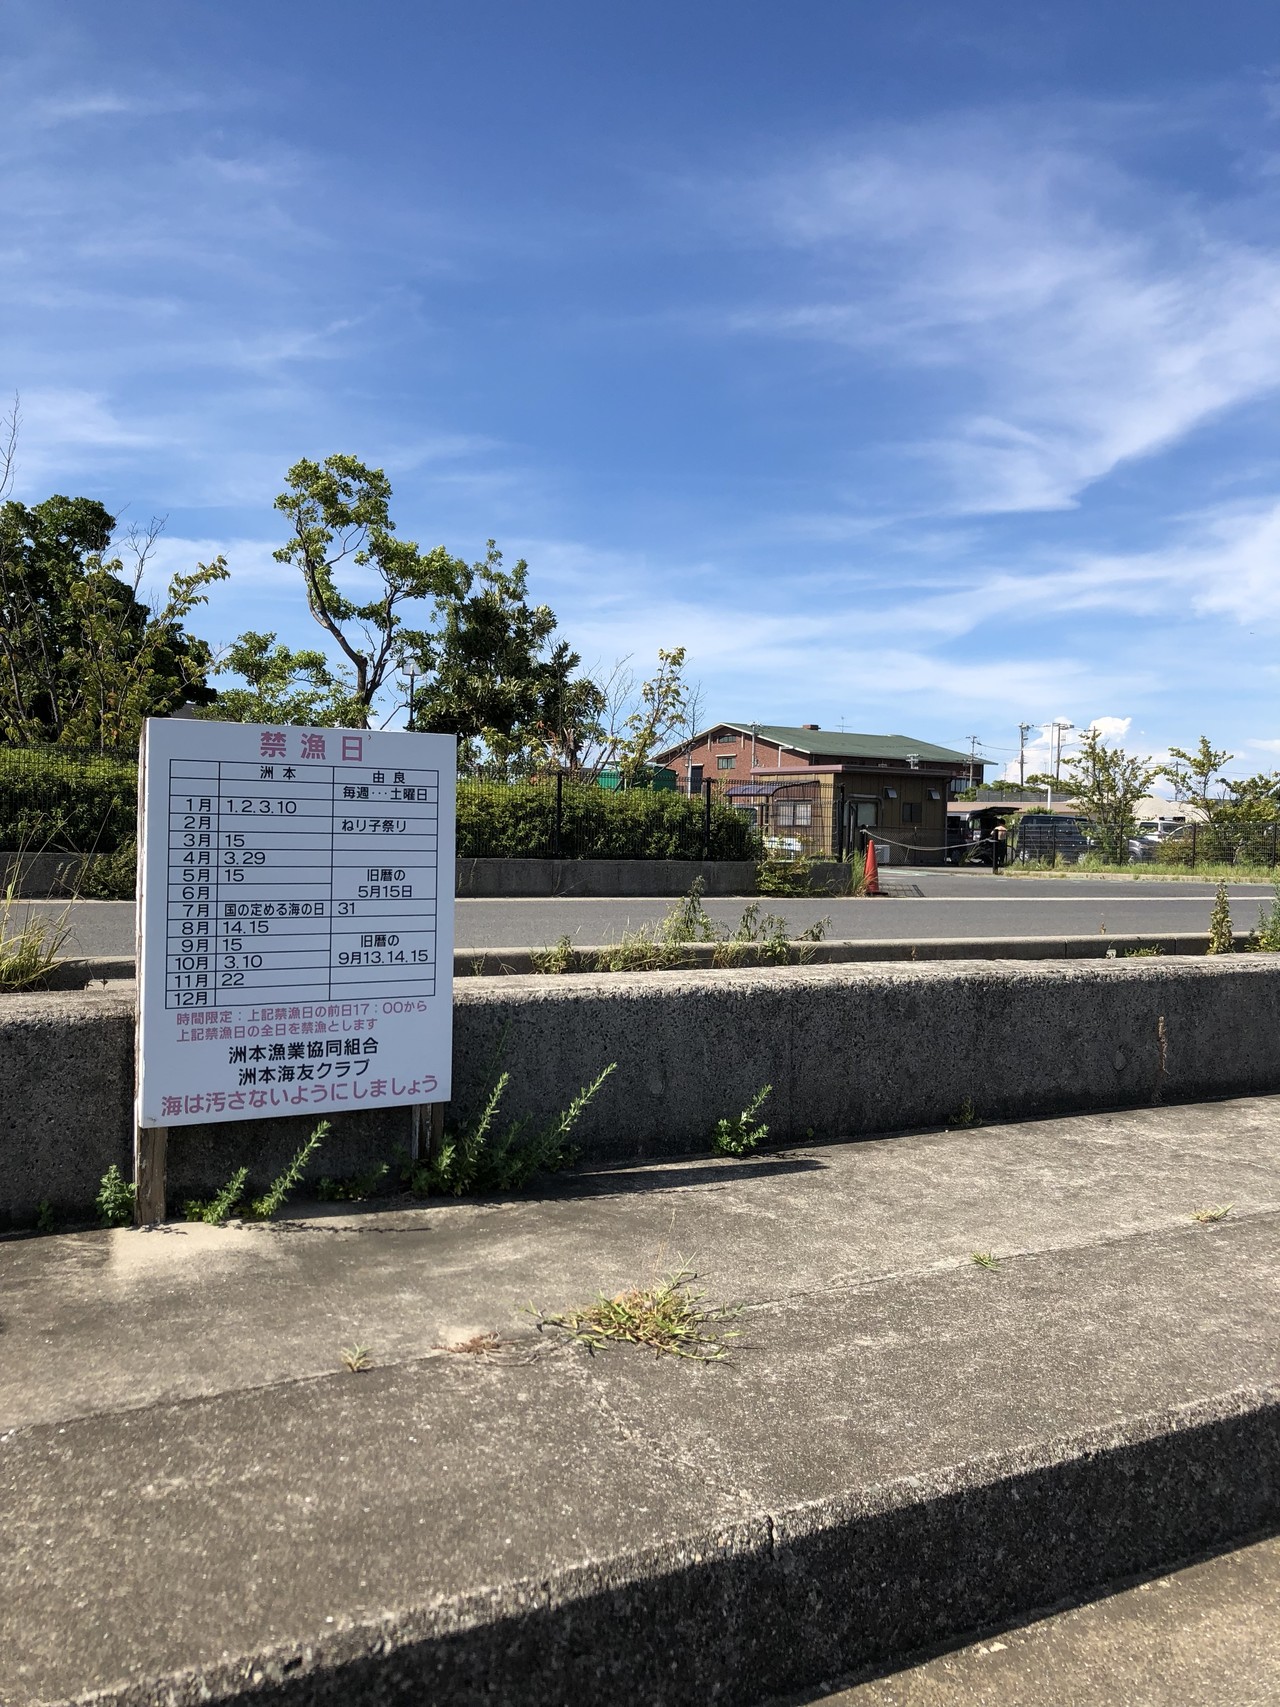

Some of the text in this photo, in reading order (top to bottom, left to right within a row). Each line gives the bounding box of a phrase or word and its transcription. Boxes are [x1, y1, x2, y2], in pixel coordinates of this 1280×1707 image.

[260, 731, 363, 761] 禁漁日
[187, 799, 211, 812] 1月
[227, 801, 297, 814] 1.2.3.10
[184, 816, 210, 829] 2月
[342, 820, 407, 832] ねり子祭り
[184, 834, 210, 847] 3月
[225, 834, 245, 847] 15
[183, 852, 210, 864] 4月
[224, 852, 265, 865] 3.29
[183, 869, 210, 882] 5月
[225, 869, 244, 882] 15
[367, 869, 405, 882] 旧暦の
[182, 887, 210, 899] 6月
[358, 886, 412, 898] 5月15日
[182, 903, 210, 917] 7月
[225, 902, 324, 916] 国の定める海の日
[338, 902, 355, 914] 31
[182, 921, 209, 935] 8月
[223, 921, 269, 934] 14.15
[182, 939, 209, 953] 9月
[223, 939, 242, 951] 15
[361, 935, 399, 948] 旧暦の
[175, 957, 208, 970] 10月
[224, 955, 262, 969] 3.10
[338, 950, 428, 965] 9月13.14.15
[175, 974, 208, 988] 11月
[221, 974, 244, 986] 22
[175, 992, 208, 1006] 12月
[177, 1018, 377, 1042] 上記禁漁日の全日を禁漁とします
[229, 1037, 379, 1064] 洲本漁業協同組合
[239, 1059, 370, 1086] 洲本海友クラブ
[161, 1075, 438, 1116] 海は汚さないようにしましょう
